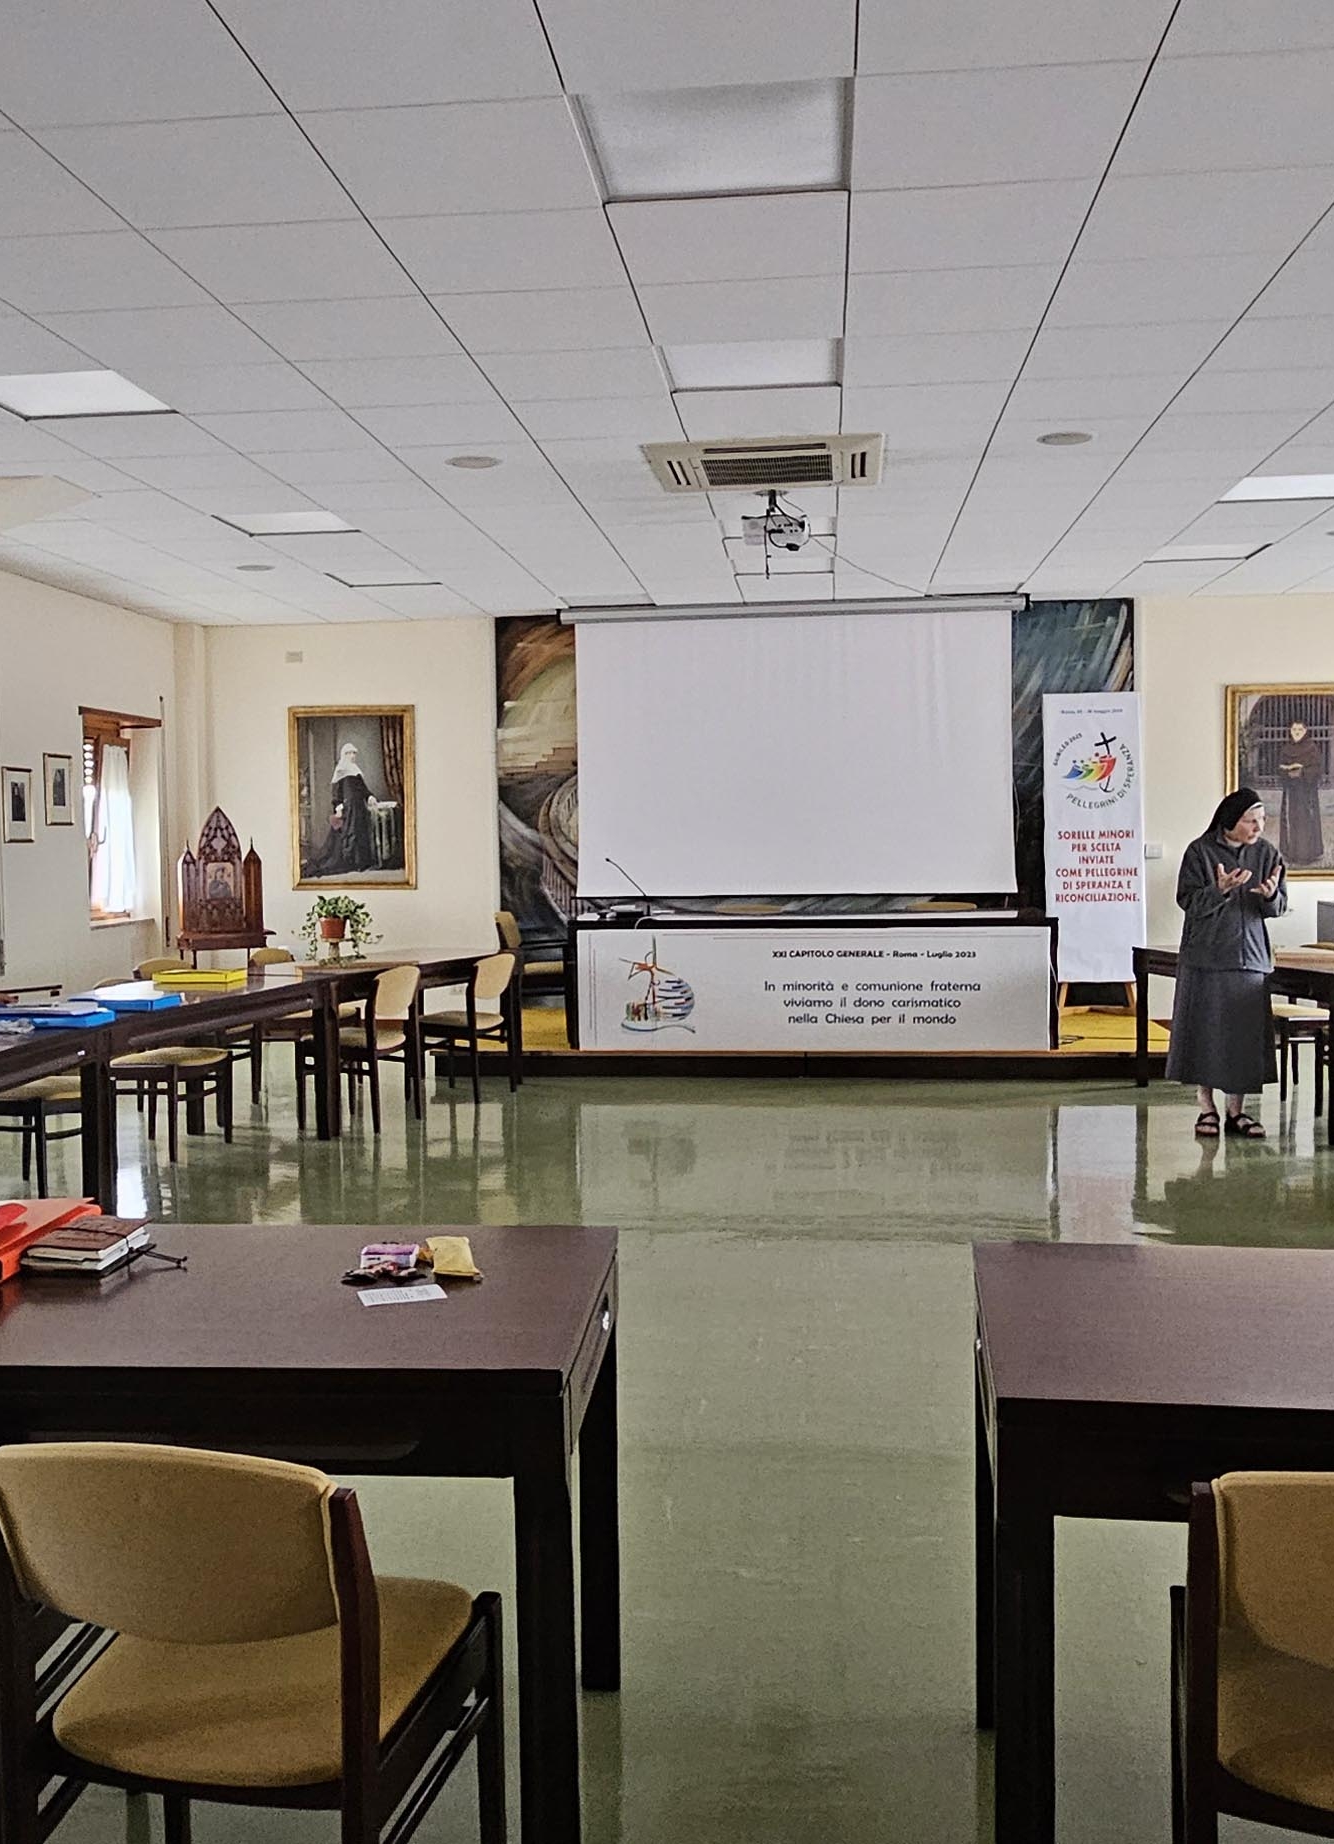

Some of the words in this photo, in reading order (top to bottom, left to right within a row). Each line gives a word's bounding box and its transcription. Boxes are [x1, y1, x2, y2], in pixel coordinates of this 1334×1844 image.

[1119, 743, 1135, 789] SPERANZA
[1117, 790, 1128, 799] DI
[1066, 793, 1119, 810] PELLEGRINI
[1057, 830, 1095, 840] SORELLE
[1098, 829, 1135, 839] MINORI
[1071, 843, 1088, 852] PER
[1090, 842, 1122, 852] SCELTA
[1078, 855, 1115, 865] INVIATE
[1055, 868, 1082, 878] COME
[1085, 867, 1138, 877] PELLEGRINE
[1062, 881, 1073, 890] DI
[1075, 880, 1124, 890] SPERANZA
[1126, 880, 1132, 889] E
[1055, 893, 1140, 903] RICONCILIAZIONE.
[771, 950, 787, 958] XXI
[789, 949, 834, 959] CAPITOLO
[836, 949, 885, 959] GENERALE
[893, 950, 919, 958] Roma
[926, 950, 953, 960] Luglio
[764, 980, 776, 991] In
[782, 980, 835, 992] minorità
[841, 983, 849, 992] e
[855, 980, 924, 992] comunione
[930, 980, 982, 992] fraterna
[783, 997, 834, 1008] viviamo
[839, 996, 847, 1008] il
[853, 997, 886, 1008] dono
[891, 997, 962, 1009] carismatico
[787, 1012, 819, 1025] nella
[824, 1012, 865, 1025] Chiesa
[870, 1015, 893, 1026] per
[898, 1012, 906, 1025] il
[912, 1012, 957, 1025] mondo
